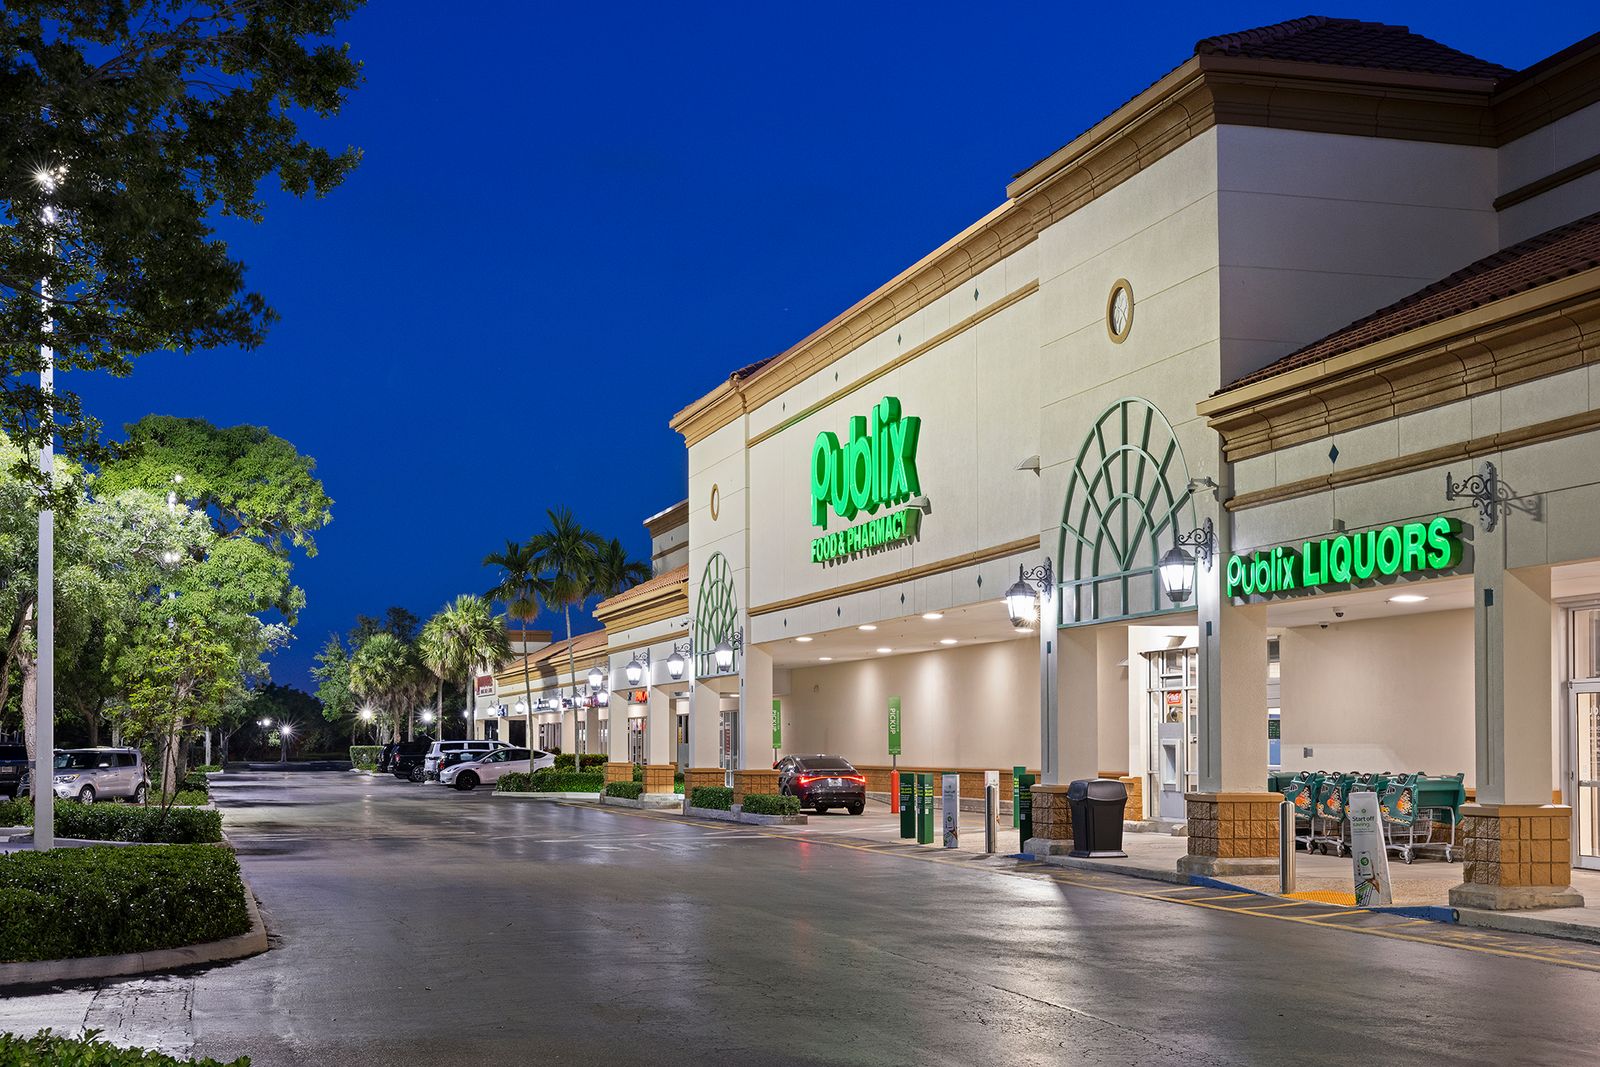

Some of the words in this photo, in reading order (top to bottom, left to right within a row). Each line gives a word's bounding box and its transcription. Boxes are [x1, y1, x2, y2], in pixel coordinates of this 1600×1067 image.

[811, 396, 921, 527] Publix
[811, 530, 838, 563] FOOD
[838, 532, 846, 555] &
[847, 509, 910, 551] PHARMACY
[1226, 546, 1297, 598] Publix
[1303, 517, 1460, 586] LIQUORS
